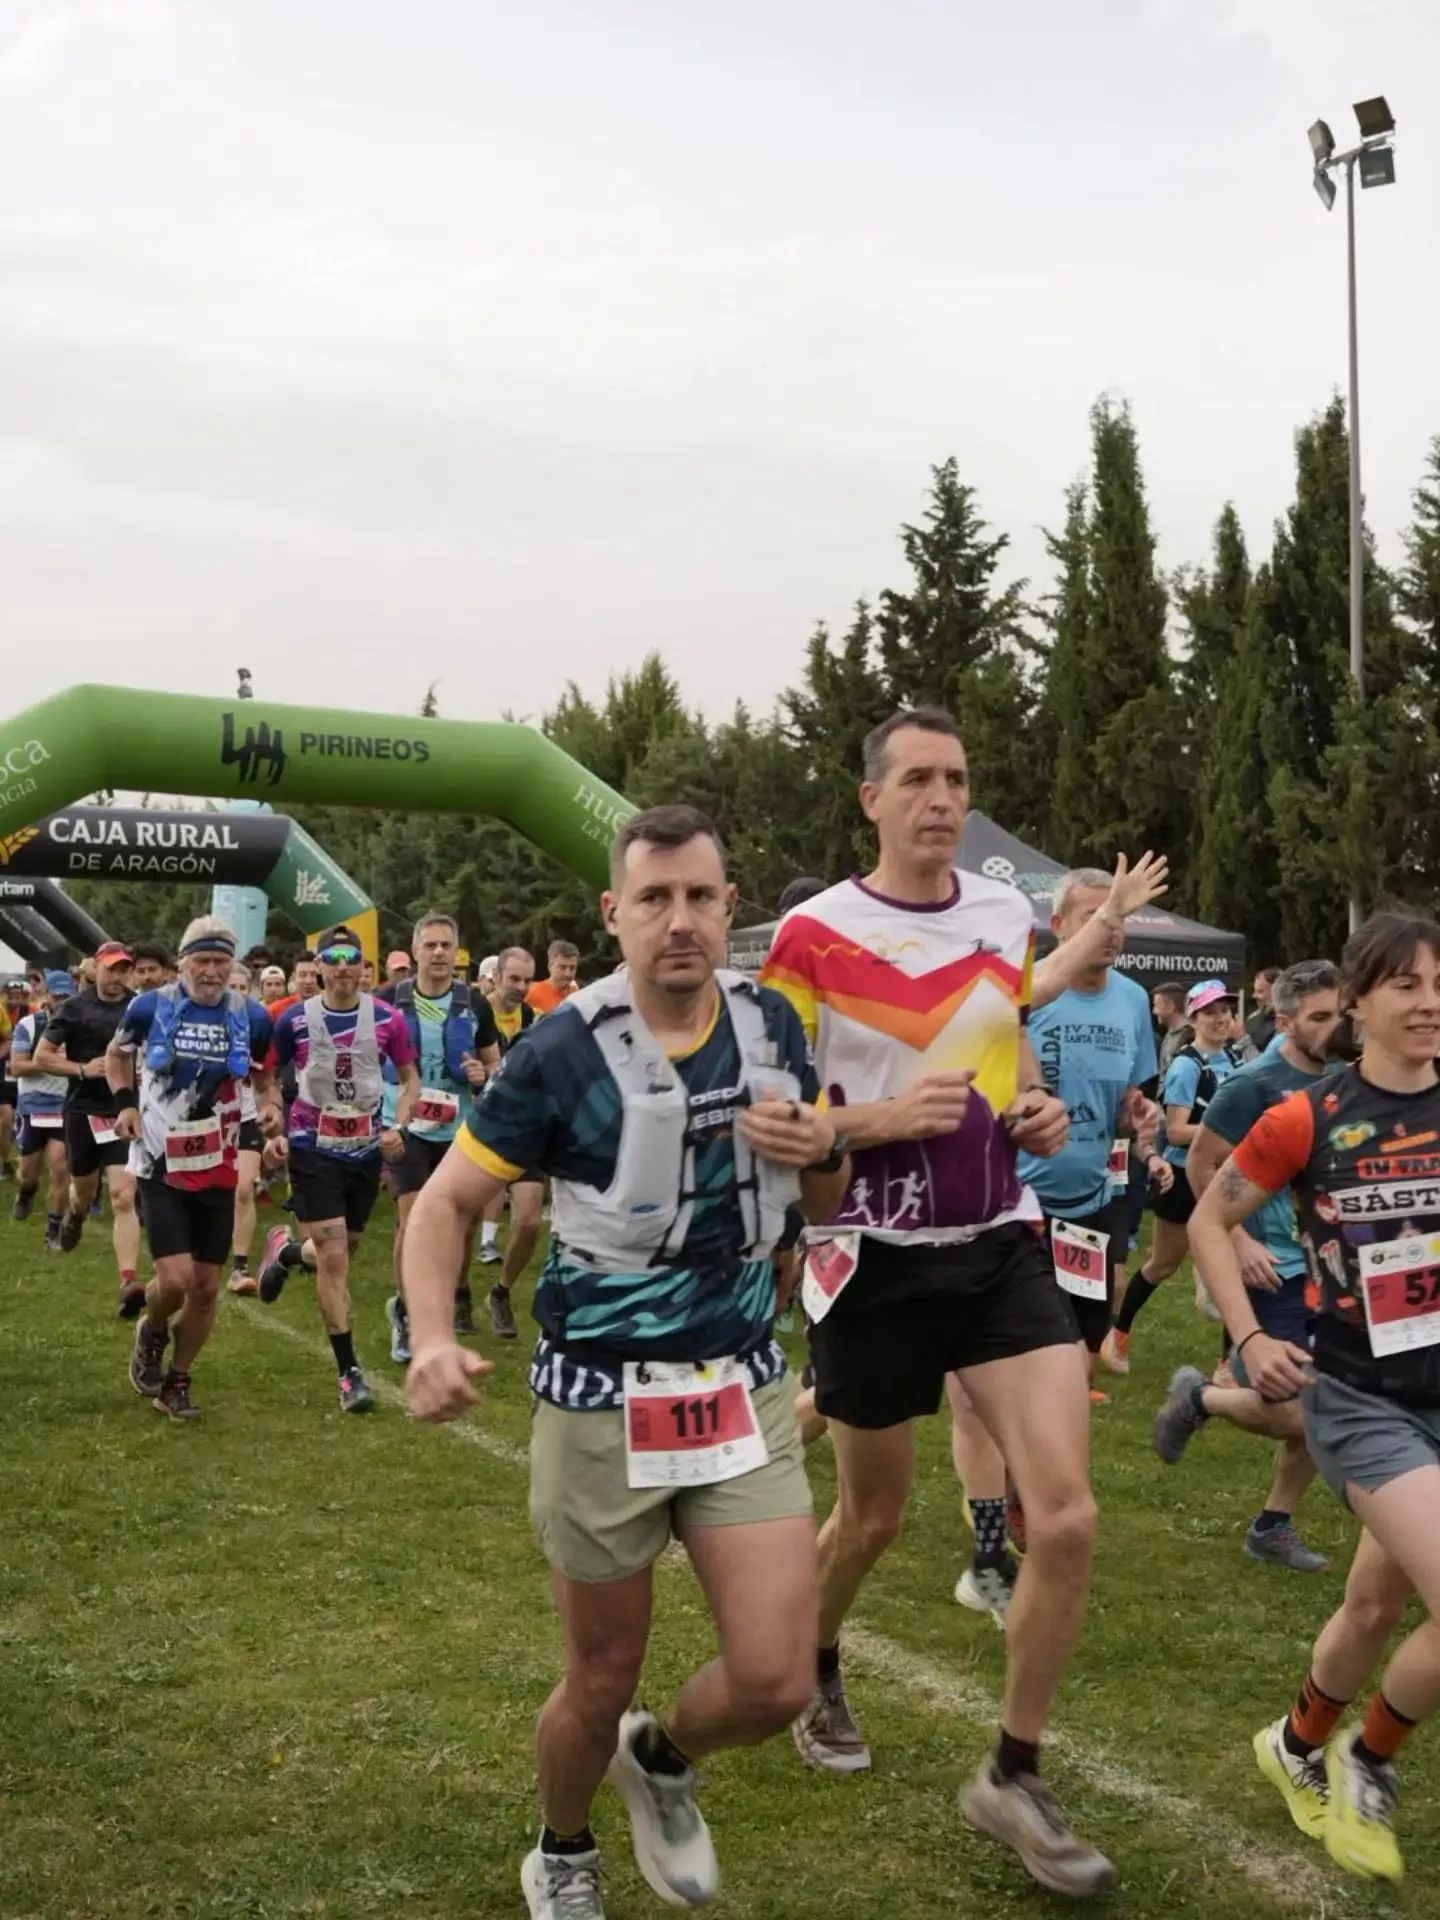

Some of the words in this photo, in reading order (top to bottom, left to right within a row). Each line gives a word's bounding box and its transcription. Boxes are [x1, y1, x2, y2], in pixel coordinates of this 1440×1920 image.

[301, 732, 430, 763] PIRINEOS
[48, 817, 129, 846] CAJA
[136, 821, 239, 849] RURAL
[68, 852, 102, 870] DE
[109, 853, 216, 874] ARAGÓN
[421, 1102, 443, 1118] 78
[335, 1118, 357, 1133] 30
[1341, 1187, 1440, 1213] SÁST
[1062, 1244, 1090, 1271] 178
[670, 1396, 720, 1437] 111
